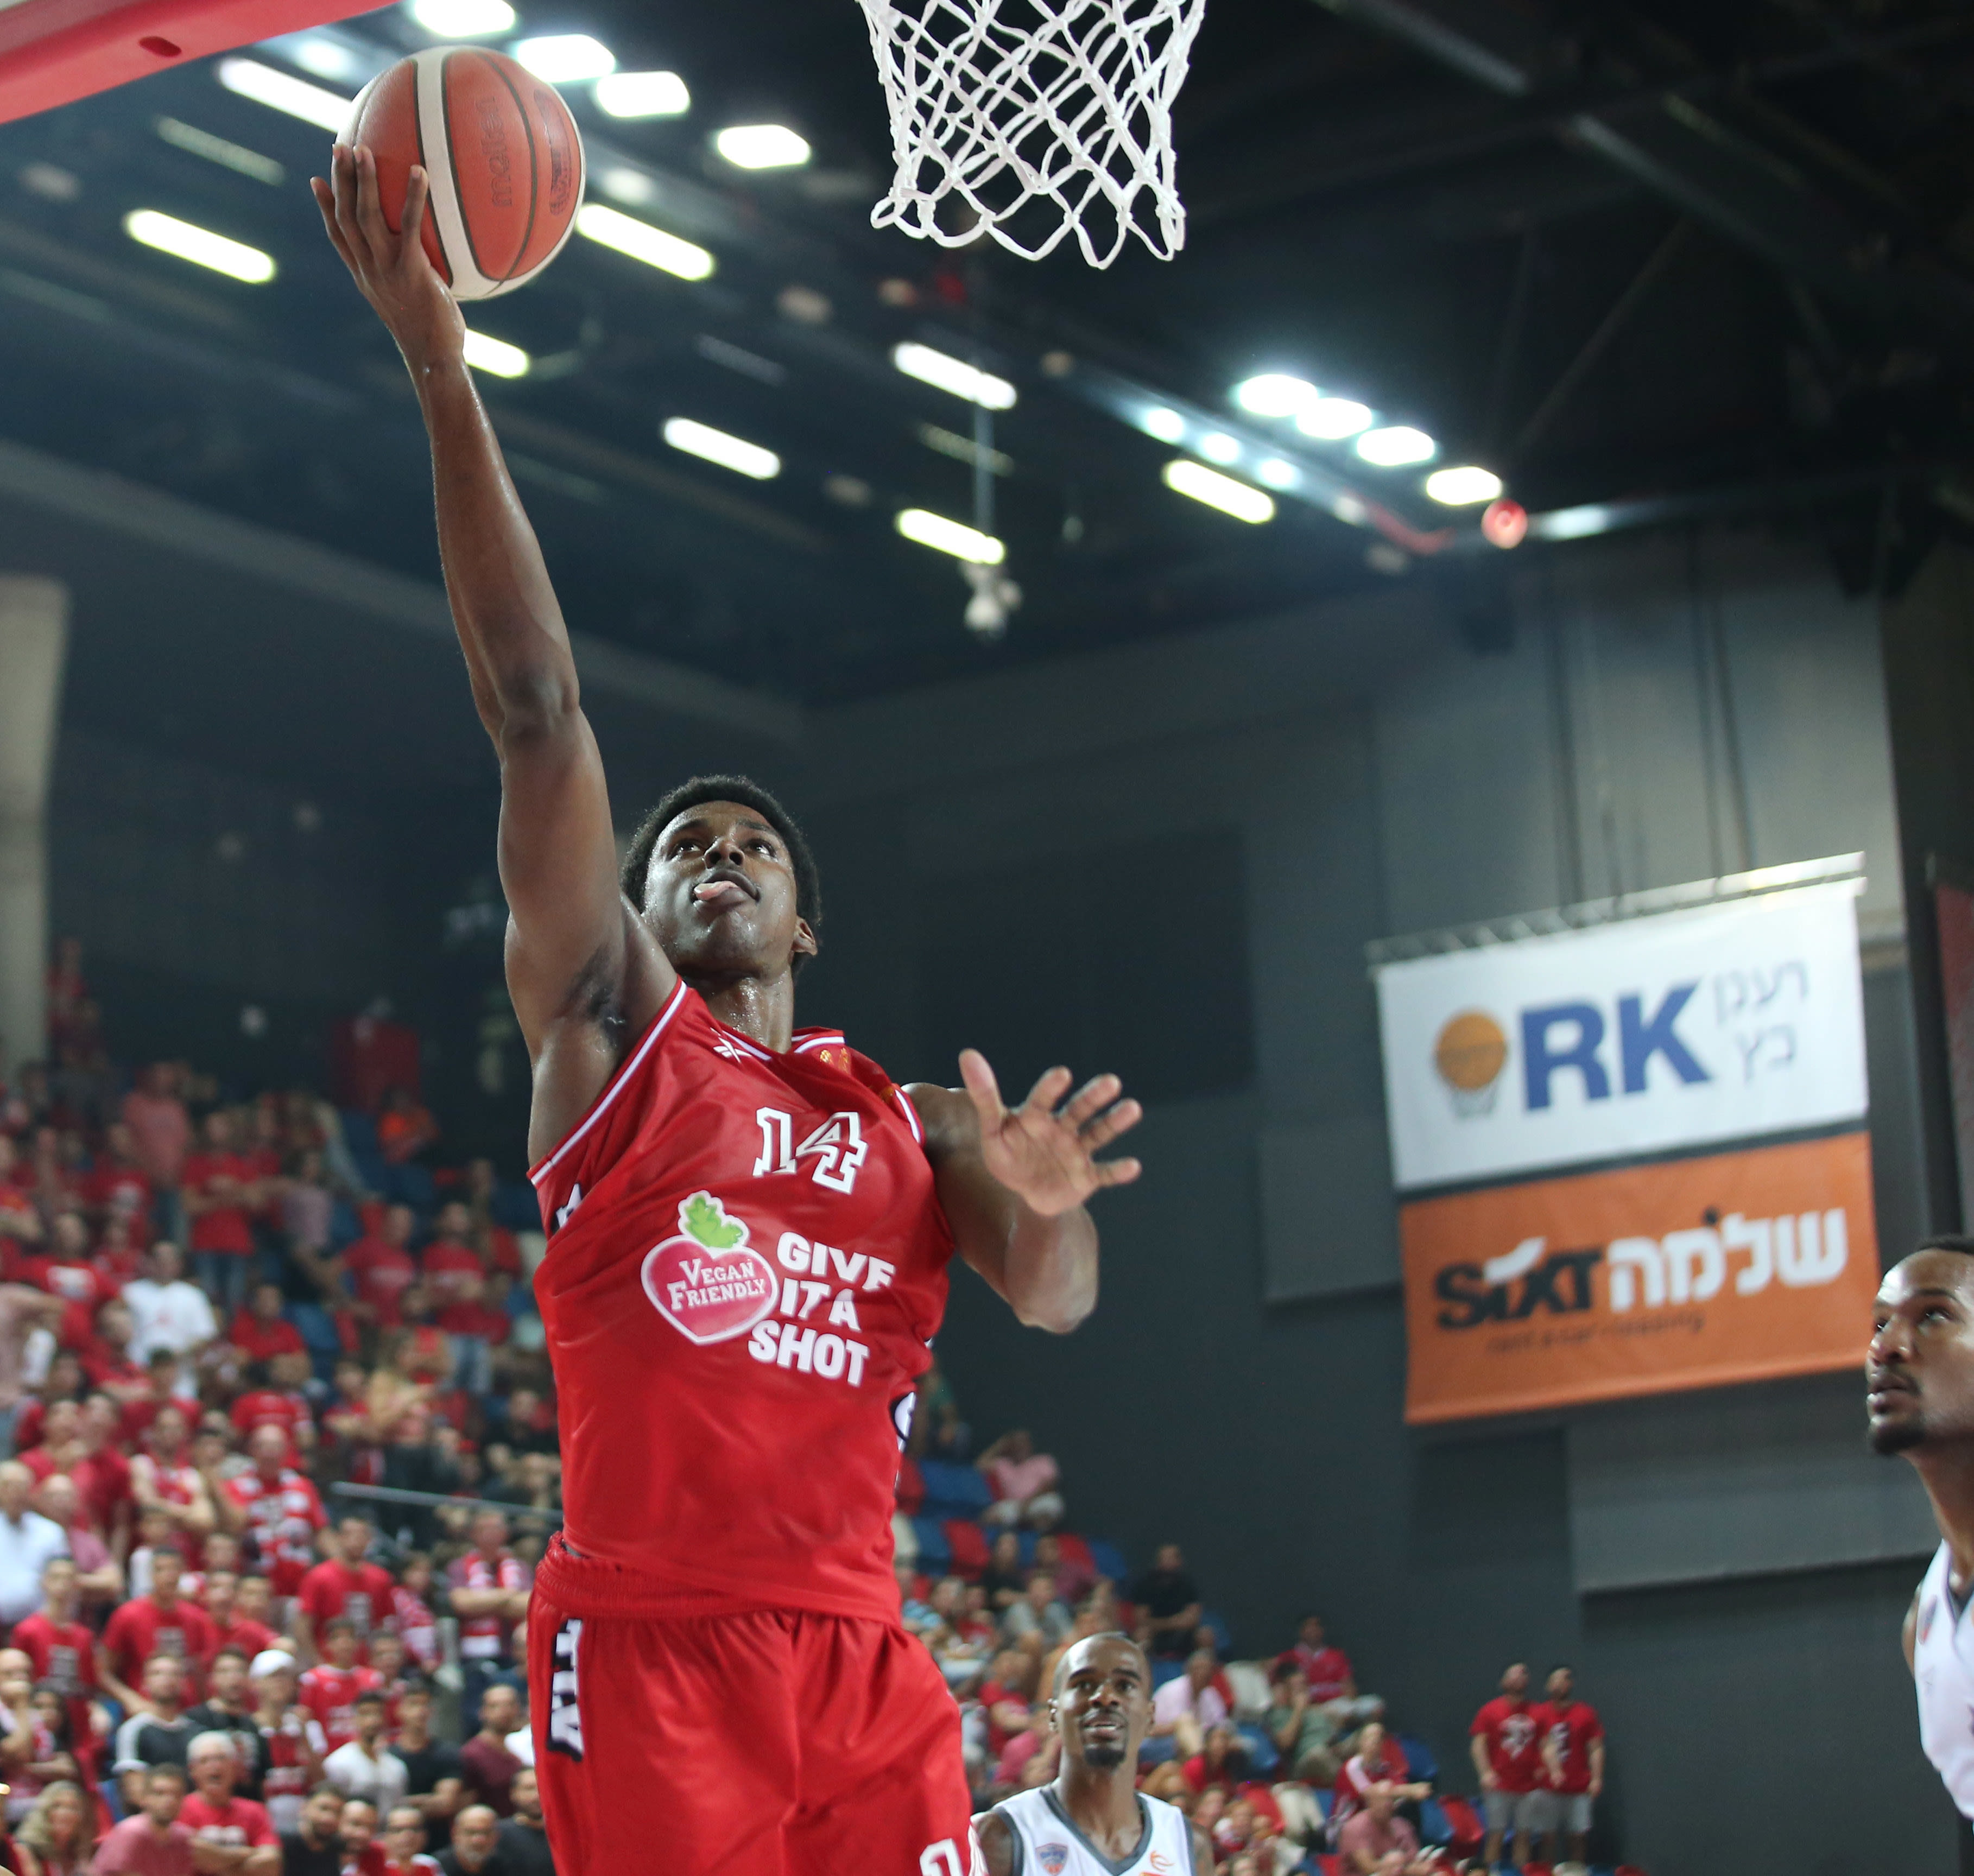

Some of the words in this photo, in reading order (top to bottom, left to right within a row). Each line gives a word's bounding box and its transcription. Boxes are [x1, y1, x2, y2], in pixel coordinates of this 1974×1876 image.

[1521, 979, 1713, 1112] RK
[752, 1106, 869, 1195] 14
[776, 1231, 896, 1291] GIVE
[1606, 1206, 1848, 1313] שלמה
[779, 1277, 831, 1321] IT
[828, 1288, 862, 1332] A
[747, 1319, 870, 1387] SHOT
